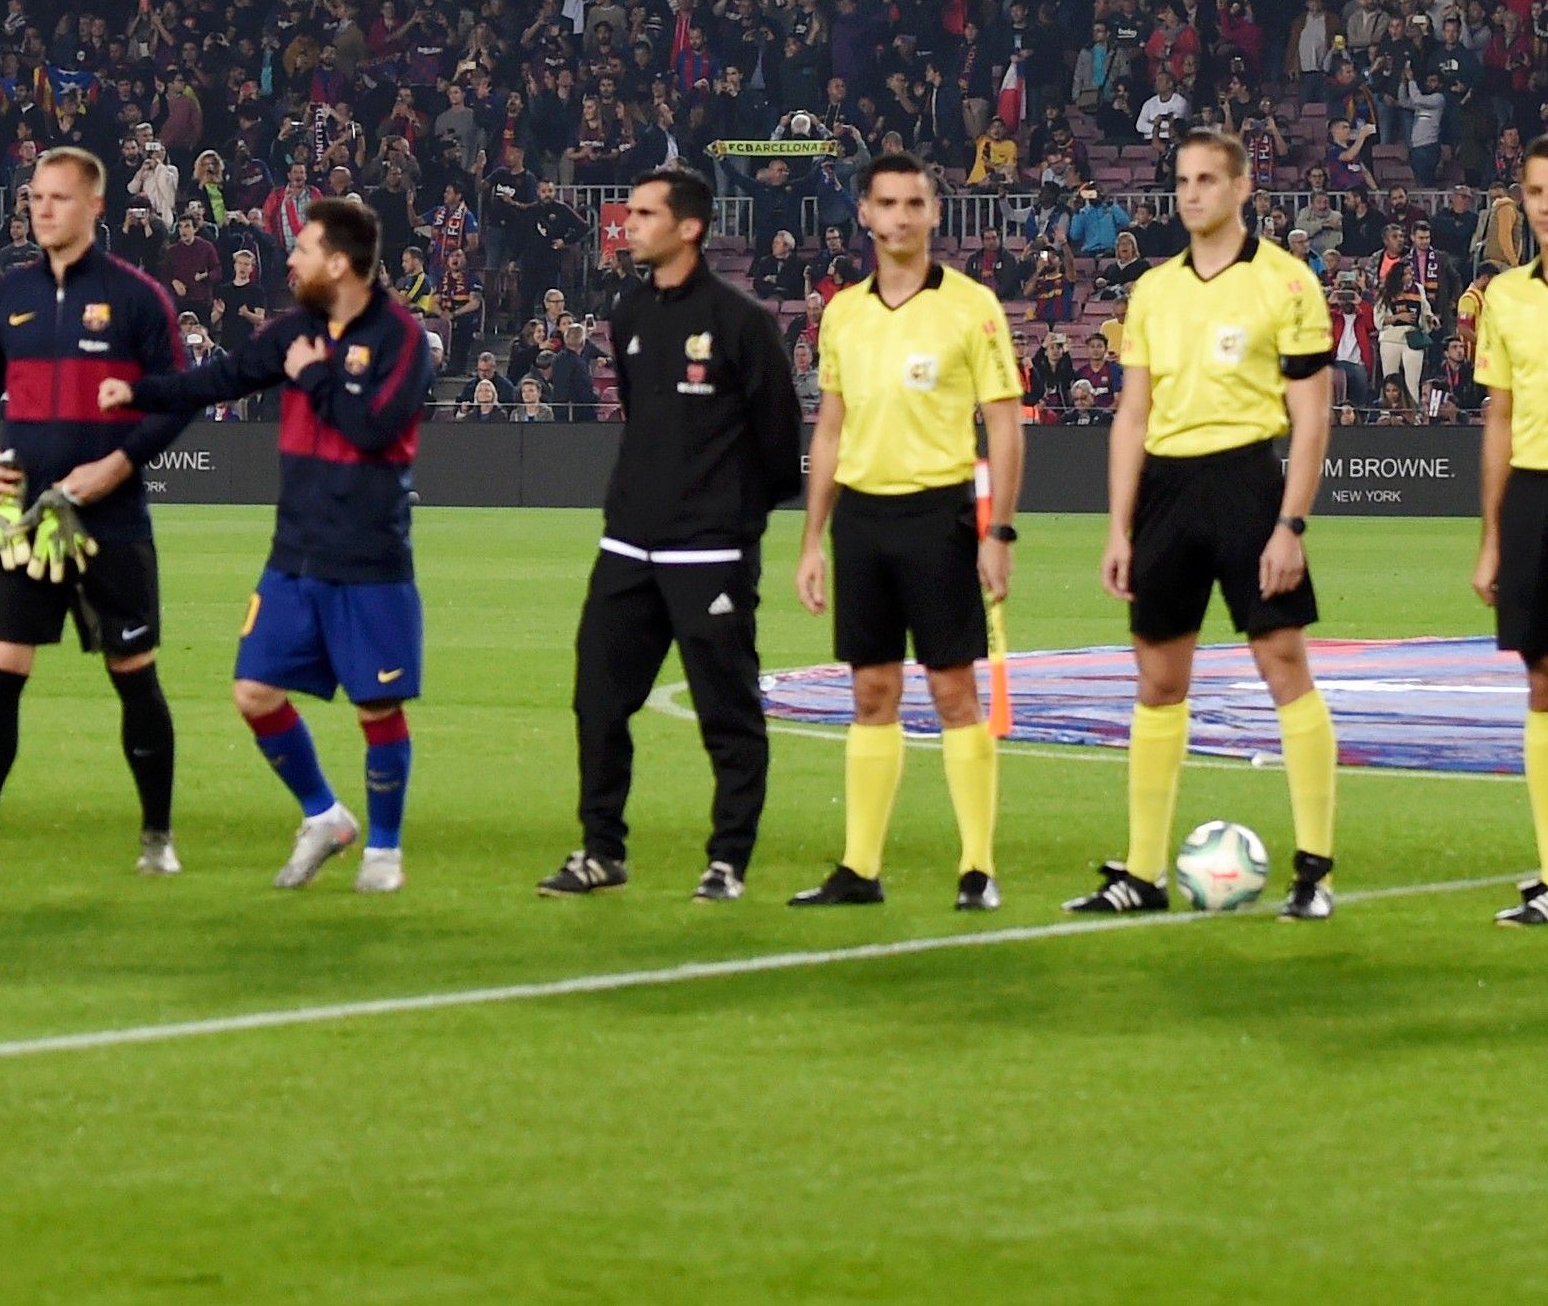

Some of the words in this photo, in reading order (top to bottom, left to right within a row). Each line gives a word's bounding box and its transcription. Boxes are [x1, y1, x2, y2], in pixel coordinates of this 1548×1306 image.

[146, 452, 216, 471] OWNE.
[1350, 459, 1456, 478] BROWNE.
[1332, 491, 1362, 502] NEW
[1366, 491, 1402, 502] YORK
